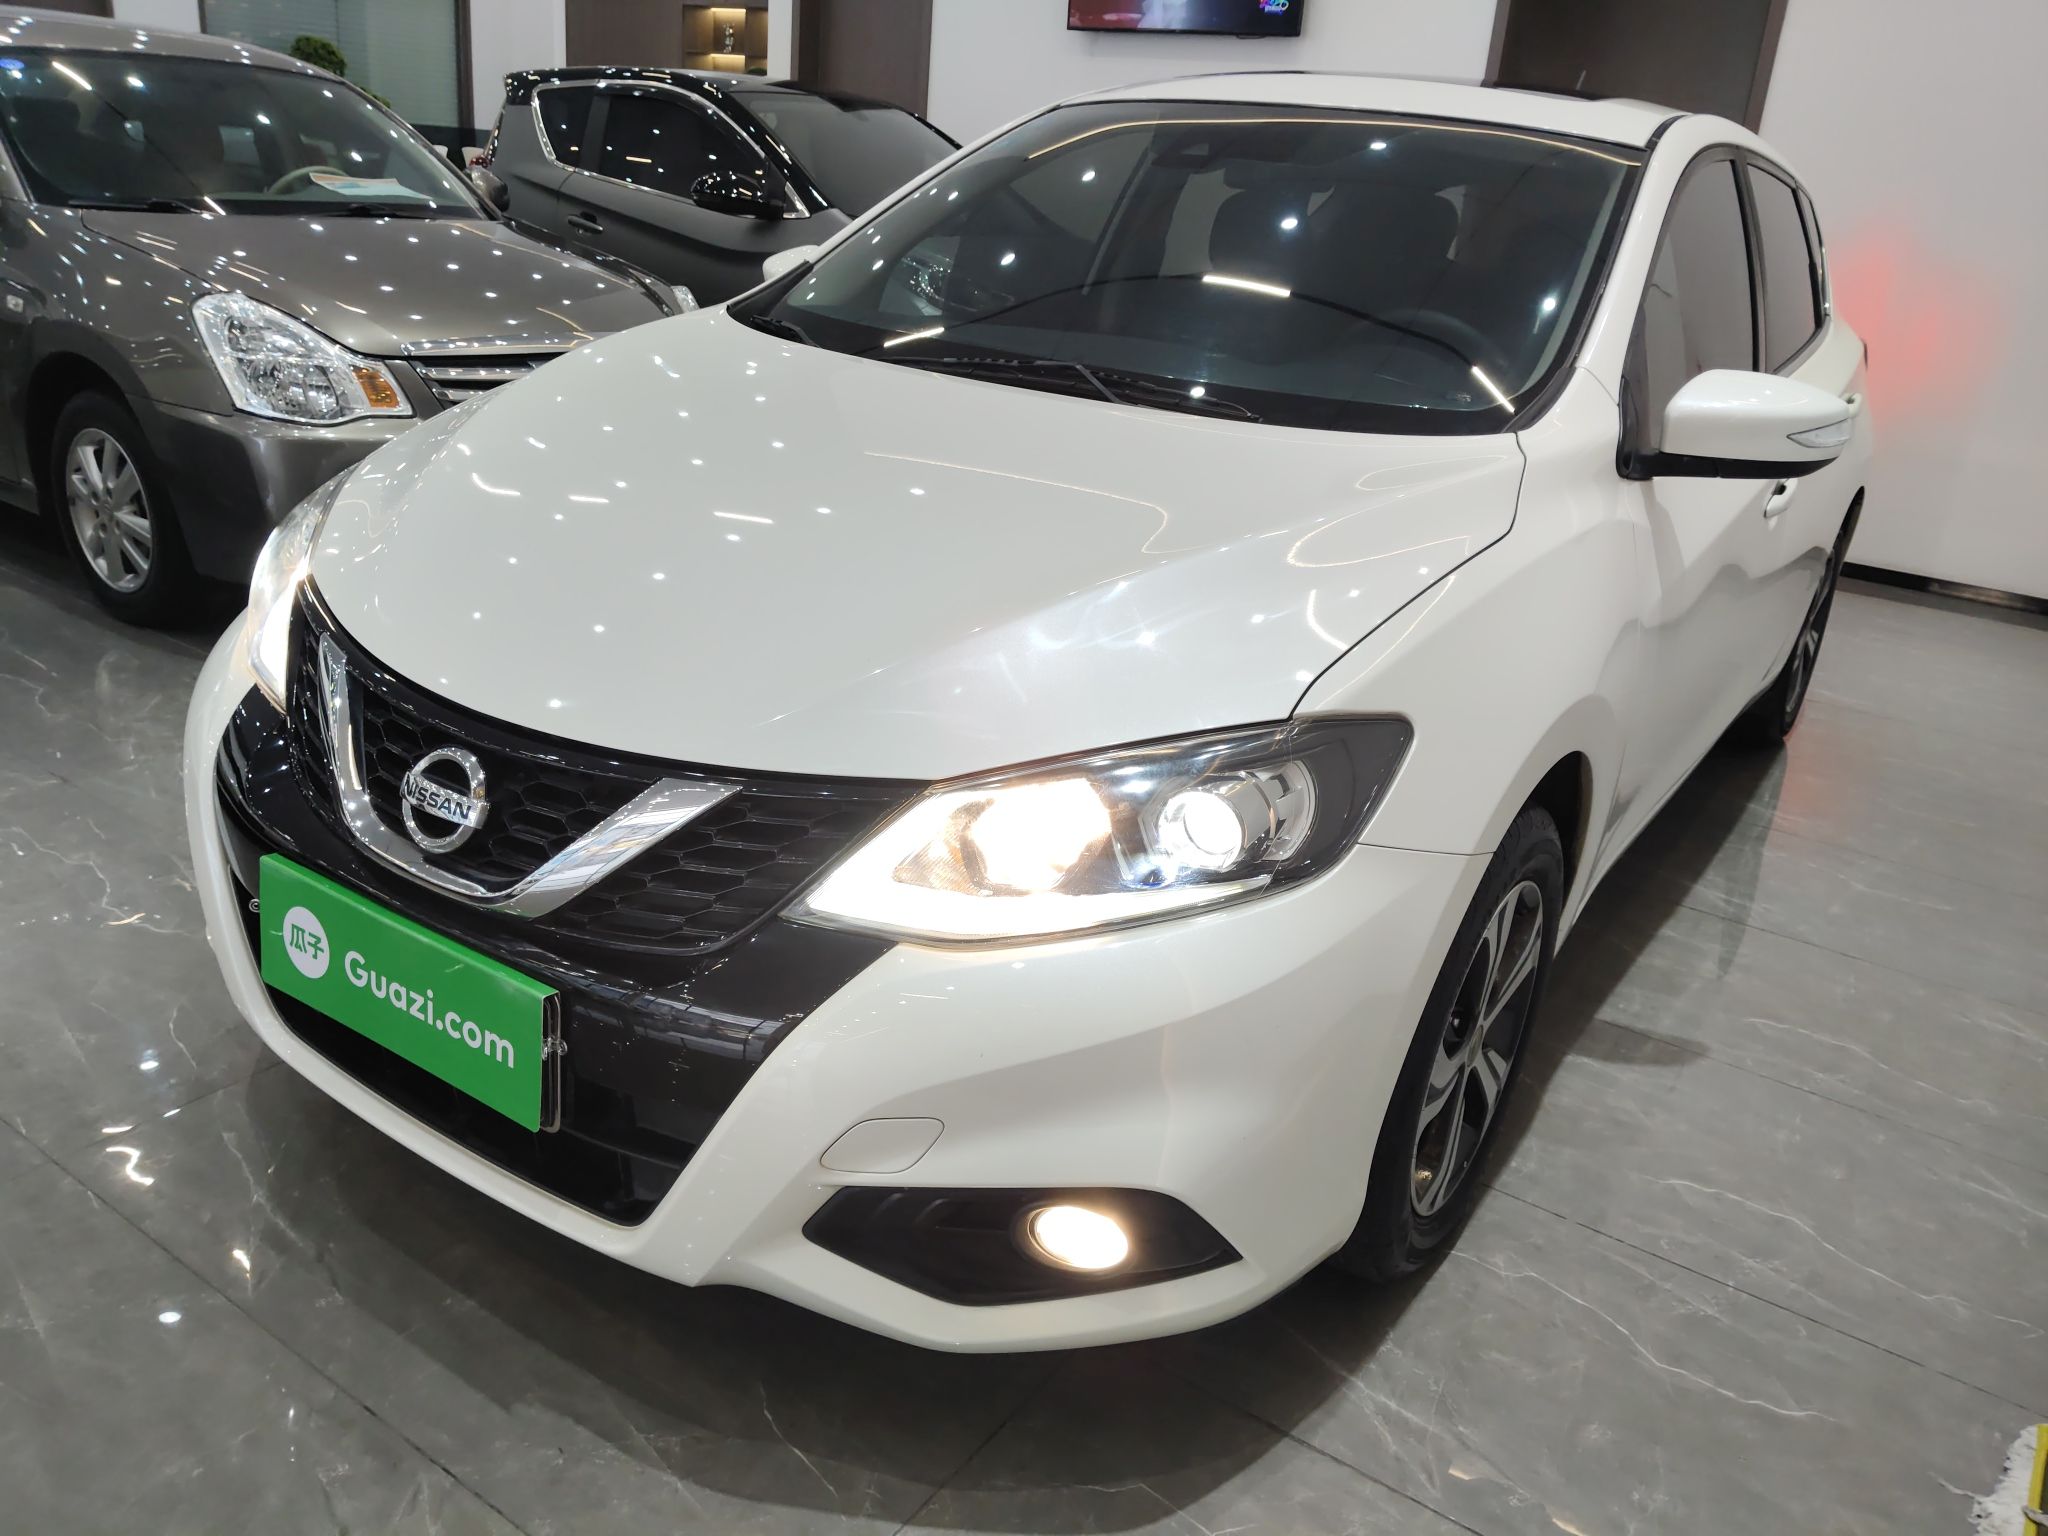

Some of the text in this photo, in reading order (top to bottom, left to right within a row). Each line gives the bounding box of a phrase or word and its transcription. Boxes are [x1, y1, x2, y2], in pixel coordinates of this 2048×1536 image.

[404, 774, 472, 820] NISSAN
[289, 923, 325, 960] 瓜子
[344, 950, 515, 1069] Guazi.com
